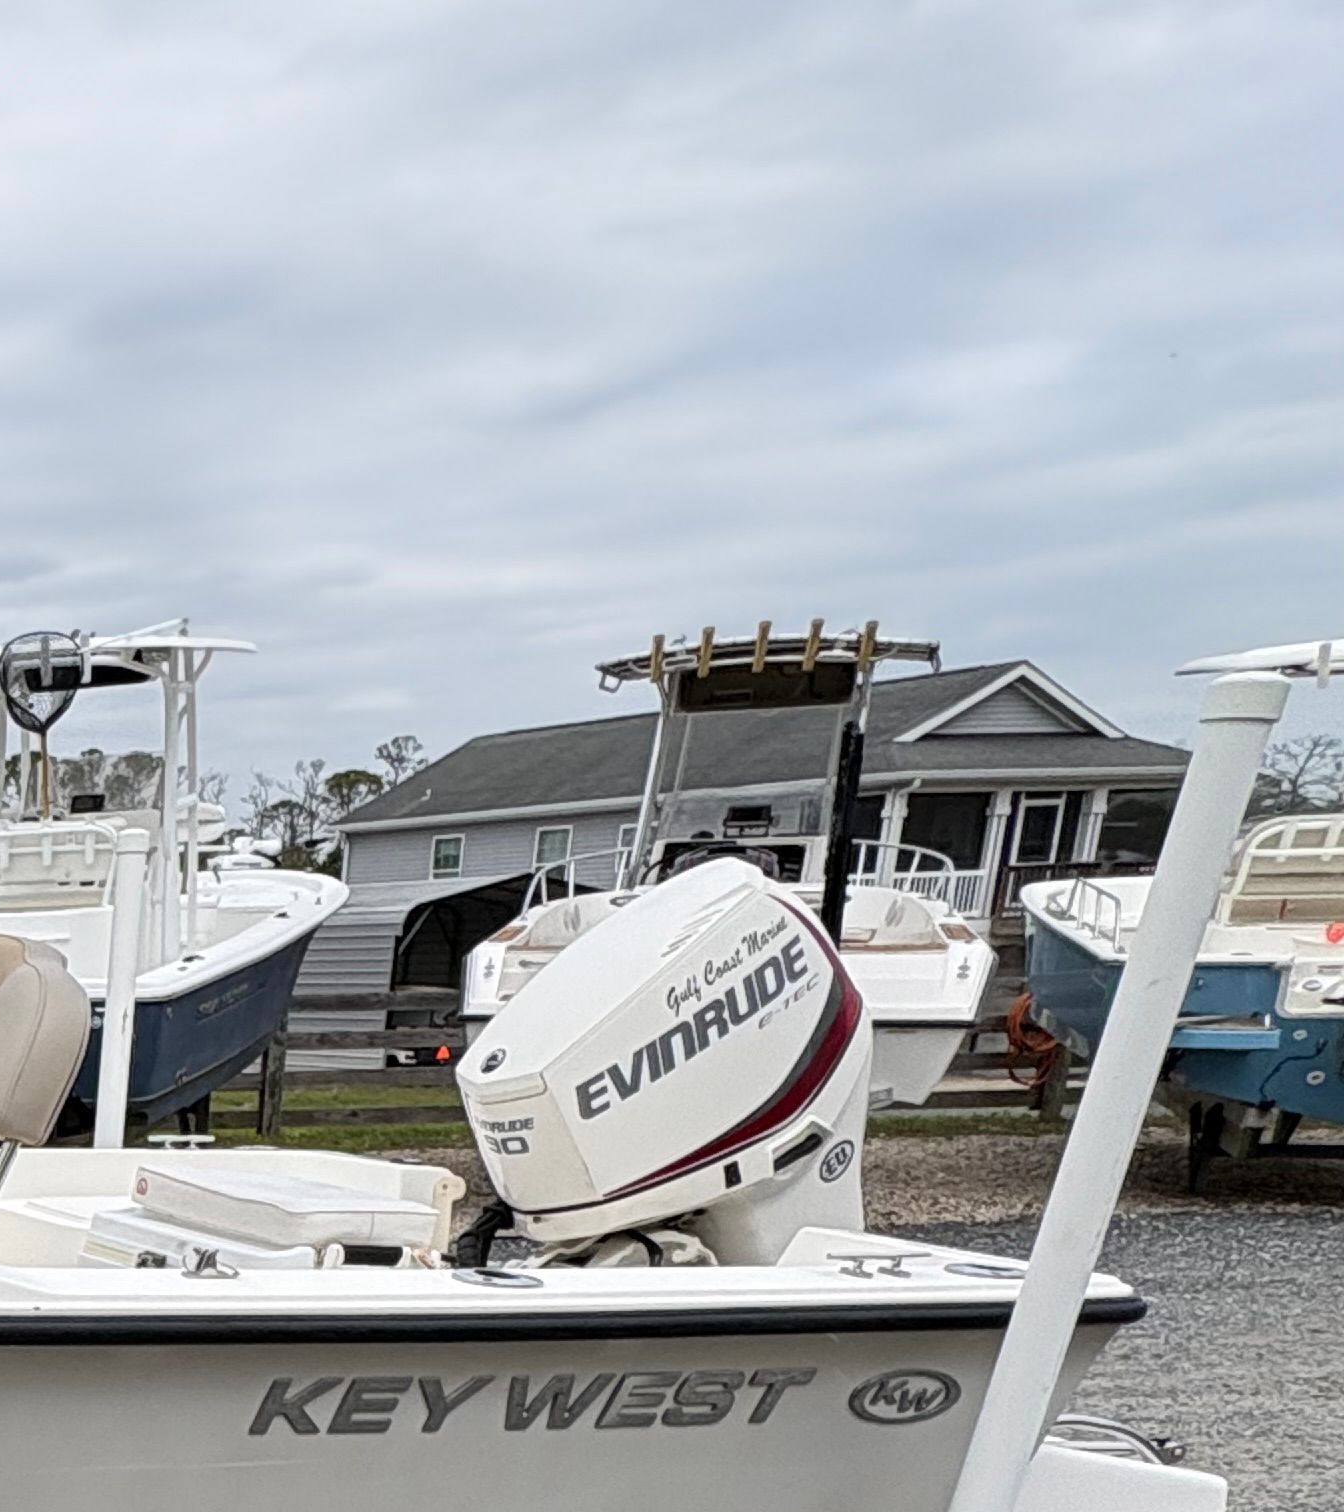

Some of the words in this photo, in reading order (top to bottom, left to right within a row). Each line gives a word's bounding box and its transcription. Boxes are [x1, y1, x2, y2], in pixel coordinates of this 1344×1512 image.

[667, 974, 701, 1017] Gulf
[704, 957, 743, 985] Coast
[741, 915, 788, 957] Marine
[575, 934, 808, 1120] EVINRUDE
[483, 1134, 530, 1156] 90
[247, 1376, 496, 1436] KEY
[502, 1366, 818, 1431] WEST
